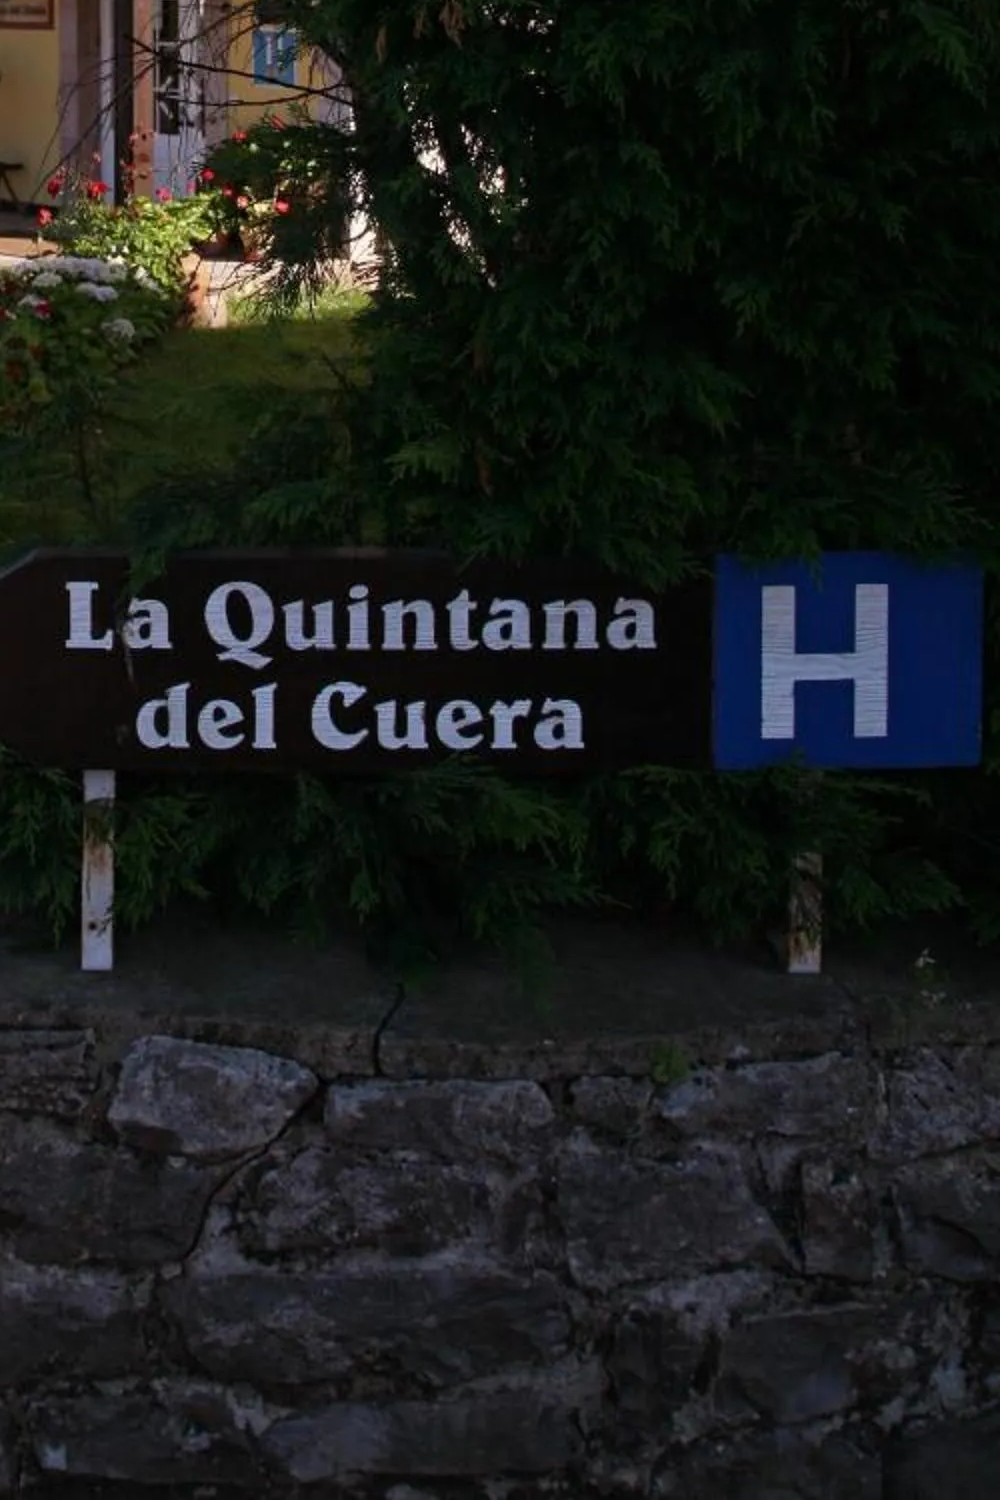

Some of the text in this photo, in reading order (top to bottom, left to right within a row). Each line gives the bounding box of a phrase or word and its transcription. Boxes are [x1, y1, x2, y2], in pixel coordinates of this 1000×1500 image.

[64, 581, 657, 669] La Quintana
[761, 583, 889, 739] H
[134, 681, 585, 751] del Cuera
